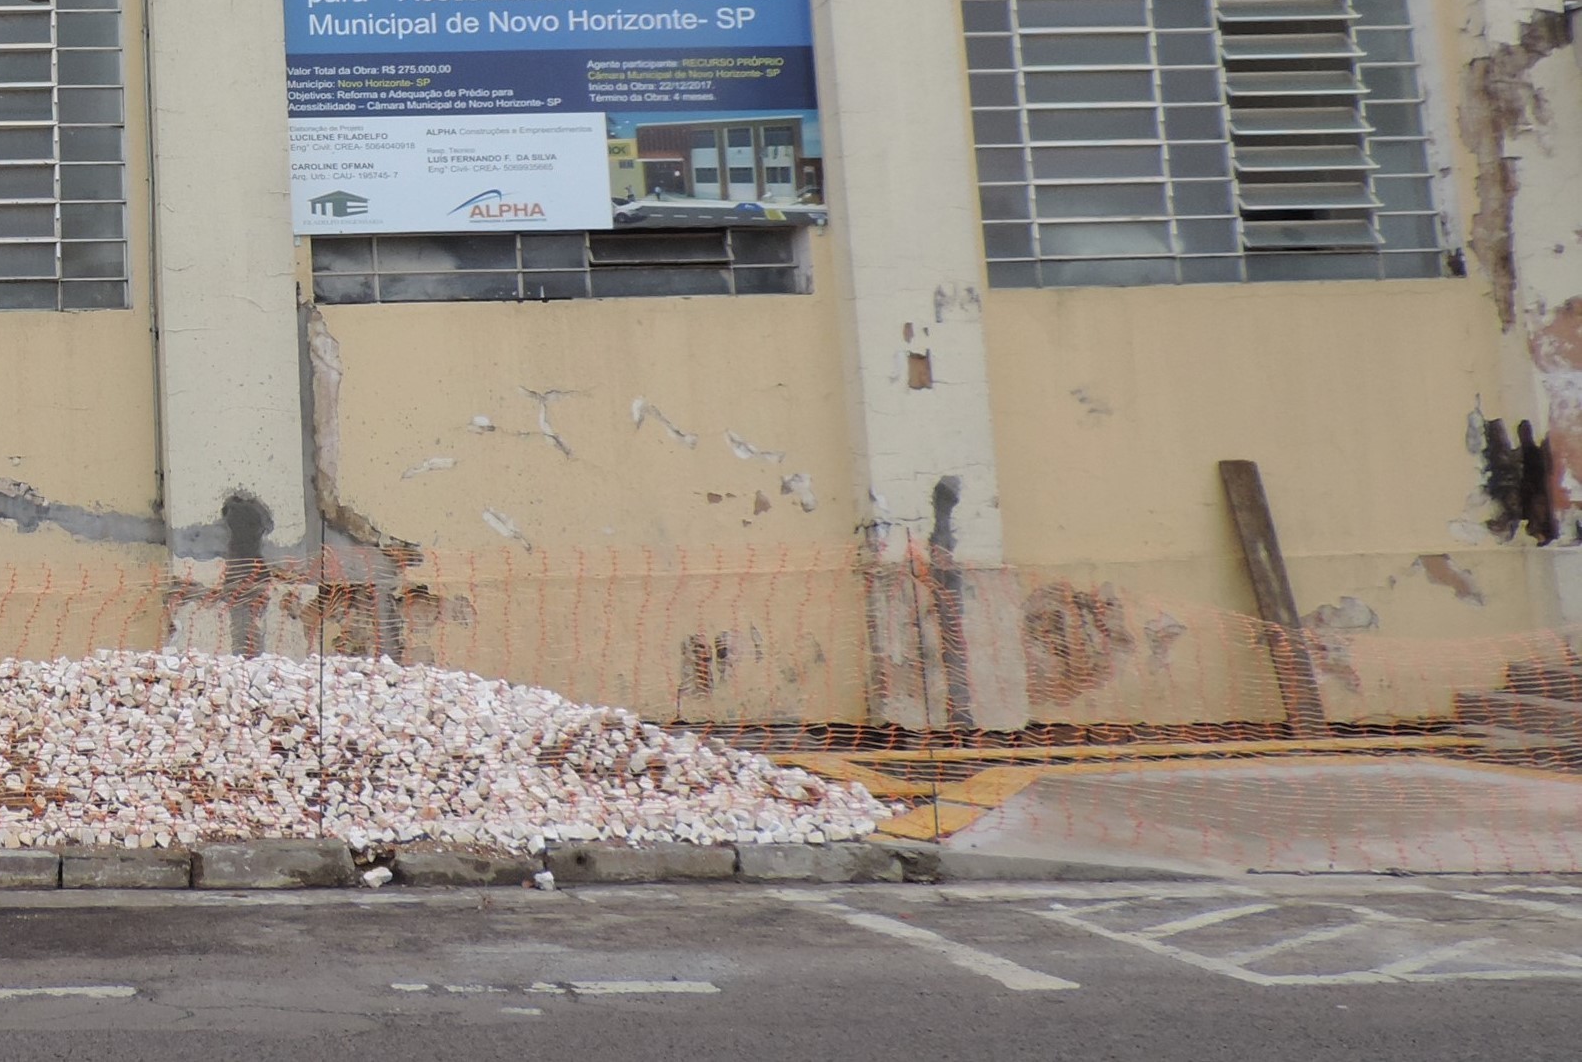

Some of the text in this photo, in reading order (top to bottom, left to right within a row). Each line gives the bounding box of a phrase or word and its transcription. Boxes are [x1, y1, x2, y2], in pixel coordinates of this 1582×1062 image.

[308, 7, 756, 40] Municipal de Novo Horizonte- SP
[587, 60, 620, 70] Agente
[682, 58, 735, 67] RECURSO
[287, 64, 452, 76] Valor Total da Obra: R$ 275.000,00
[588, 70, 625, 80] Câmara
[627, 70, 672, 80] Municipal
[674, 70, 687, 79] de
[688, 69, 714, 78] Novo
[766, 68, 781, 77] SP
[338, 79, 363, 88] Novo
[365, 79, 414, 88] Horizonte-
[416, 78, 431, 87] SP
[616, 82, 628, 90] da
[630, 82, 657, 91] Obra:
[288, 91, 335, 101] Objetivos:
[337, 90, 378, 99] Reforma
[388, 89, 443, 100] Adequação
[444, 89, 456, 98] de
[458, 88, 490, 97] Prédio
[491, 89, 514, 98] para
[589, 93, 628, 102] Término
[630, 93, 642, 102] da
[644, 93, 671, 102] Obra:
[673, 93, 680, 101] 4
[288, 101, 356, 111] Acessibilidade
[367, 101, 405, 110] Câmara
[407, 100, 452, 110] Municipal
[454, 100, 467, 109] de
[469, 99, 494, 108] Novo
[496, 99, 544, 108] Horizonte-
[547, 98, 562, 107] SP
[426, 128, 457, 136] ALPHA
[459, 127, 510, 136] Construções
[519, 126, 592, 135] Empreendimentos
[290, 133, 388, 141] LUCILENE FILADELFO
[451, 154, 502, 163] FERNANDO
[531, 153, 557, 161] SILVA
[291, 162, 374, 171] CAROLINE OFMAN
[470, 203, 545, 218] ALPHA
